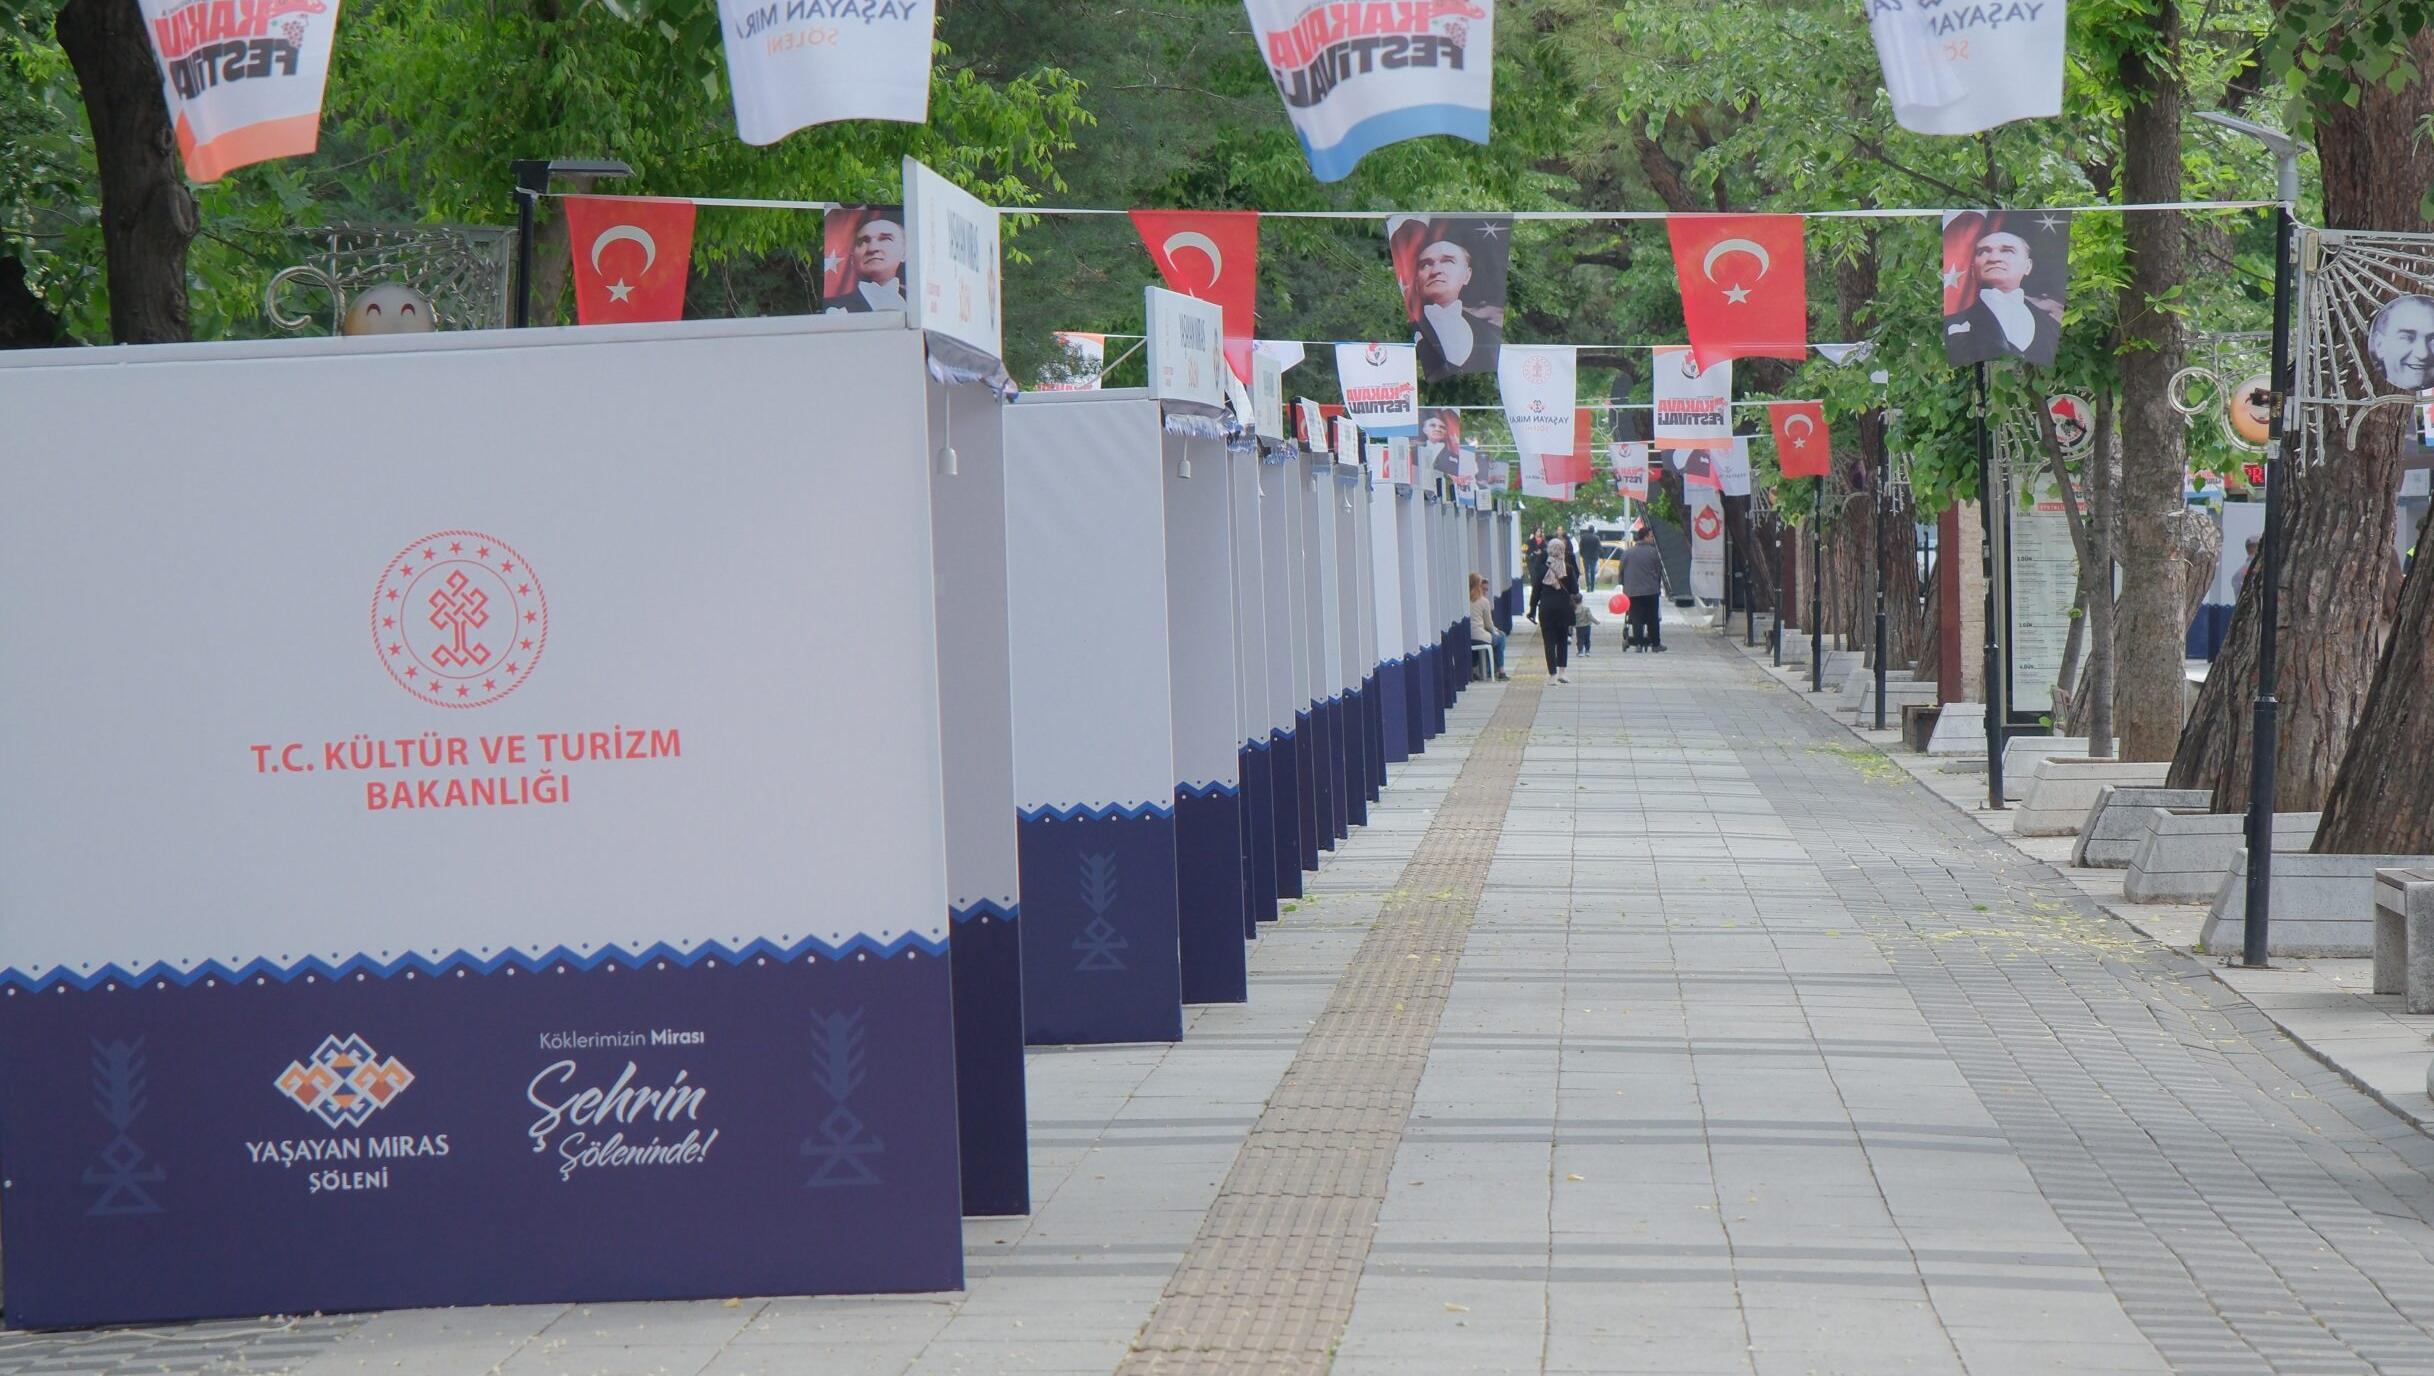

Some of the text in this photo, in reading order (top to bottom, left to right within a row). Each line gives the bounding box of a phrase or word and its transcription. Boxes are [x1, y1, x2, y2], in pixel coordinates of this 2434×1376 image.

[250, 724, 682, 774] T.C. KÜLTÜR VE TURİZM
[366, 769, 571, 811] BAKANLIĞI
[540, 1028, 705, 1049] Köklerimizin Mirası
[527, 1059, 706, 1153] Şehrin
[245, 1134, 449, 1168] YAŞAYAN MİRAS
[558, 1127, 719, 1182] Şöleninde!
[309, 1166, 388, 1194] ŞÖLENİ
